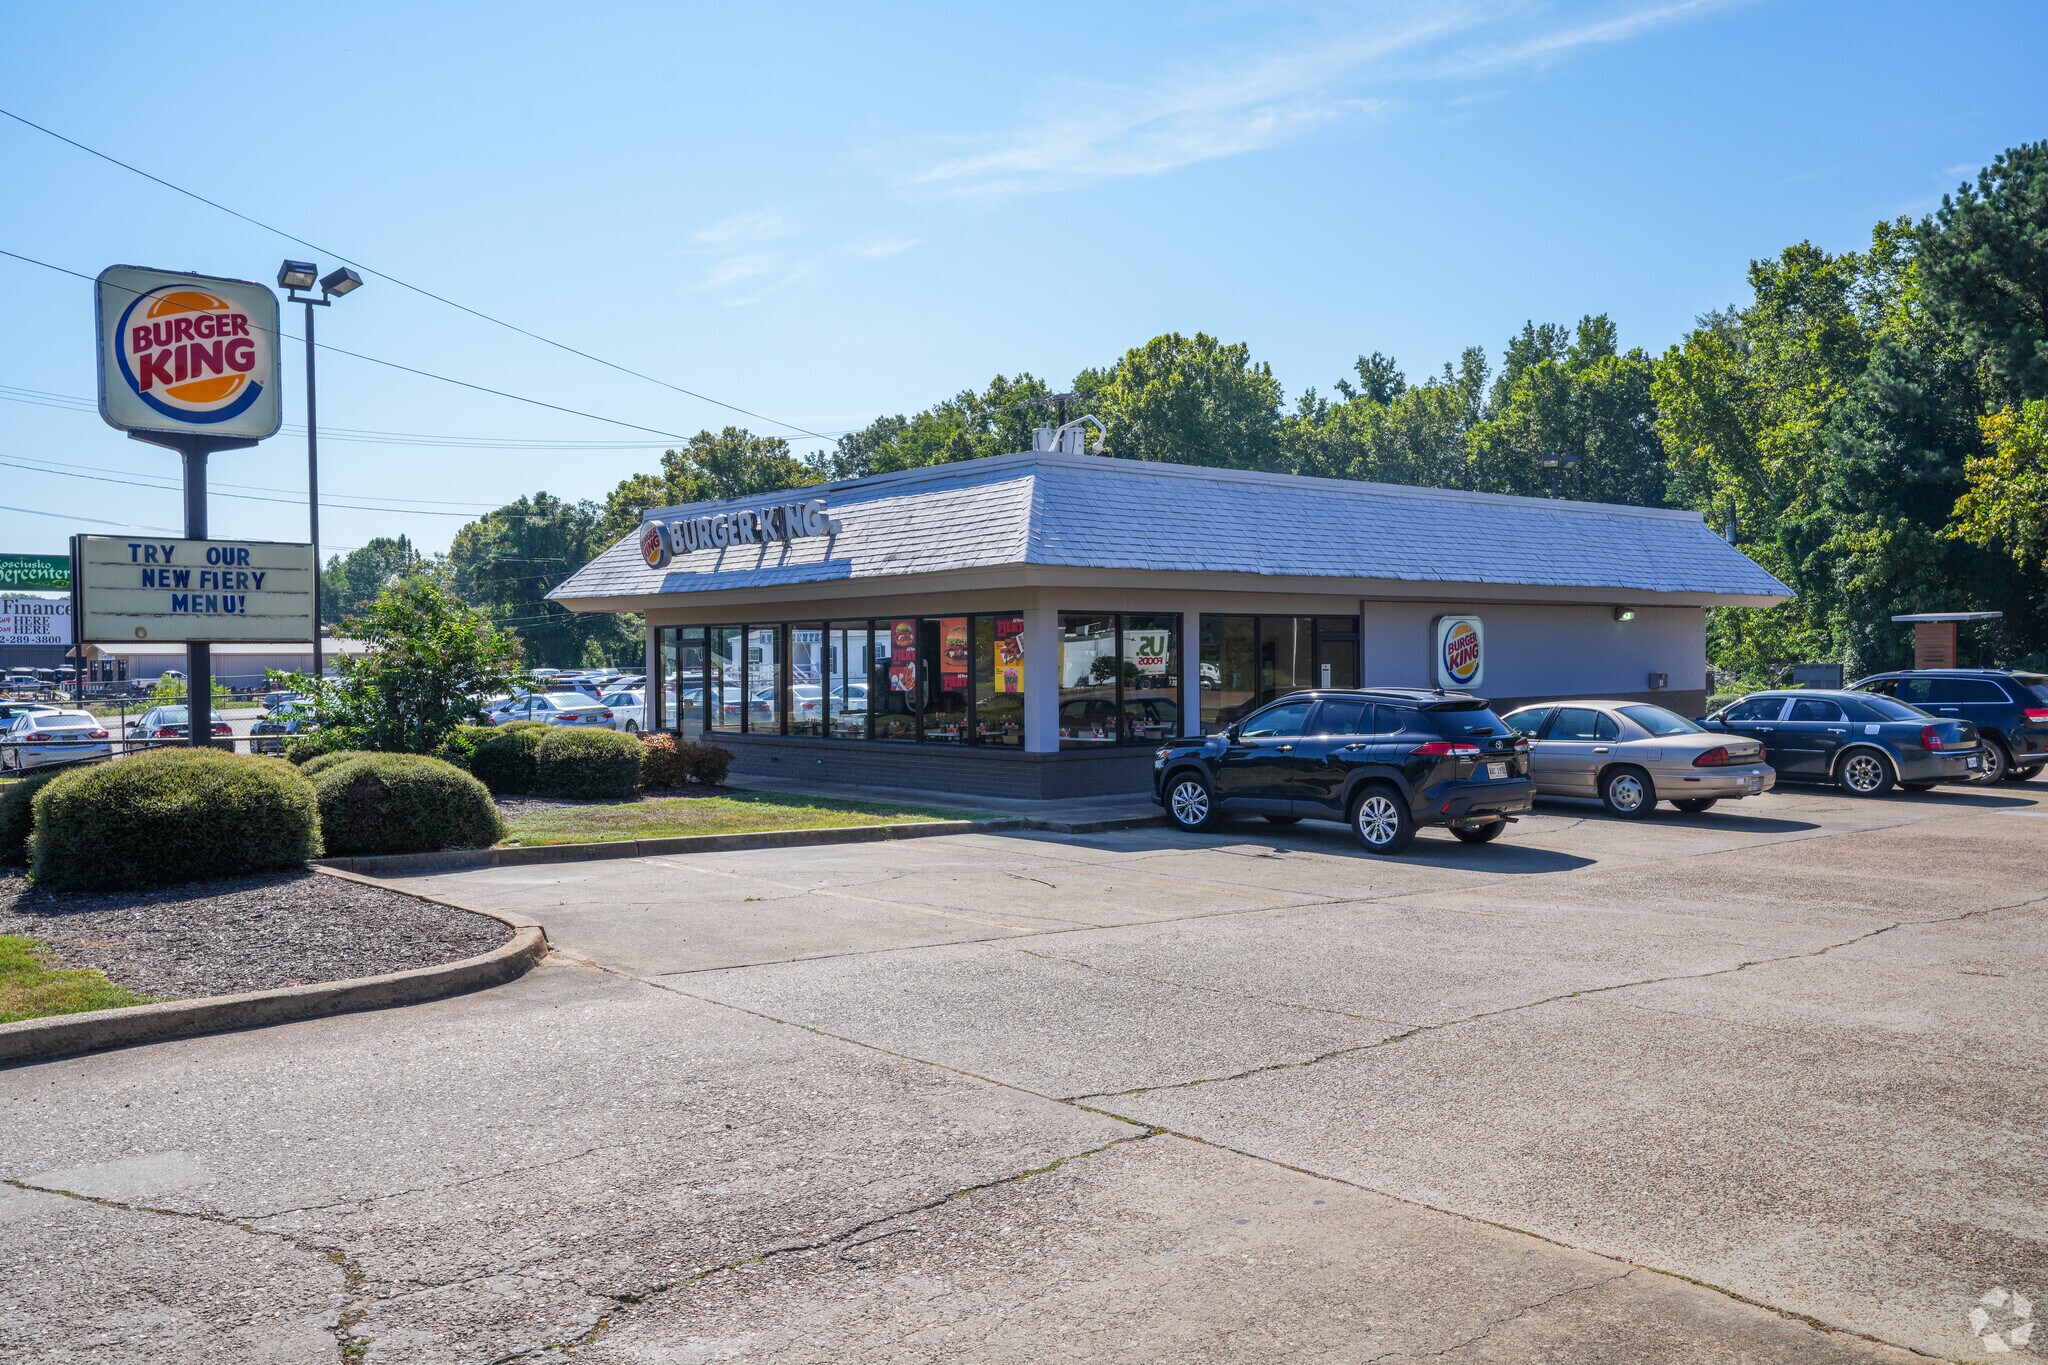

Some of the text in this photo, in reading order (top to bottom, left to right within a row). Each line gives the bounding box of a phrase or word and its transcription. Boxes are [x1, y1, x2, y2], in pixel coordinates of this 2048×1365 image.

[132, 313, 250, 354] BURGER
[139, 337, 256, 392] KING
[669, 499, 828, 554] BURGER KNG
[128, 543, 250, 566] TRY OUR
[142, 568, 266, 590] NEW FIERY
[3, 599, 71, 616] Finance
[172, 593, 246, 614] MENU!
[0, 616, 50, 626] uy HERE
[14, 625, 50, 635] HERE
[997, 620, 1024, 637] FIERY
[1447, 632, 1478, 656] BURGER
[1449, 643, 1479, 671] KING
[943, 675, 968, 690] FIERY
